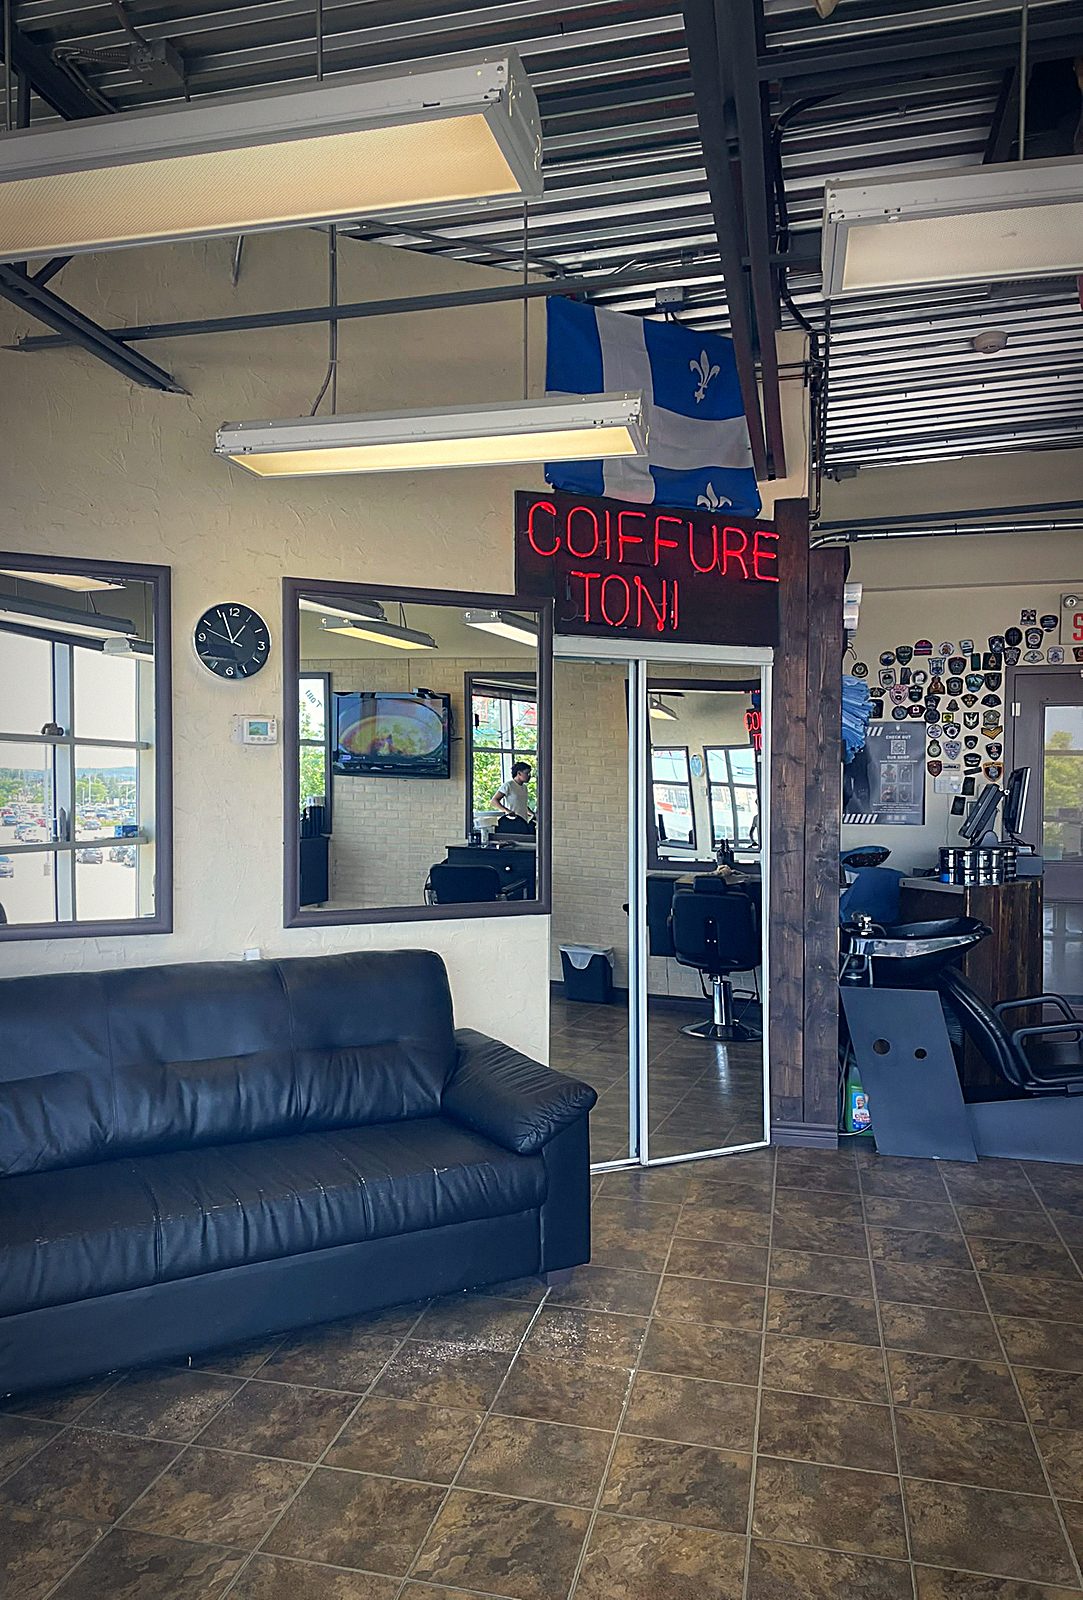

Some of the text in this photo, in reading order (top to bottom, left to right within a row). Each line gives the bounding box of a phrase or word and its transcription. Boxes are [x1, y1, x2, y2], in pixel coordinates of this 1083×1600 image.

[528, 501, 780, 583] COIFFURE
[570, 570, 679, 632] TONI
[229, 607, 241, 617] 12
[198, 632, 207, 642] 9
[257, 641, 266, 651] 3
[225, 666, 234, 676] 6
